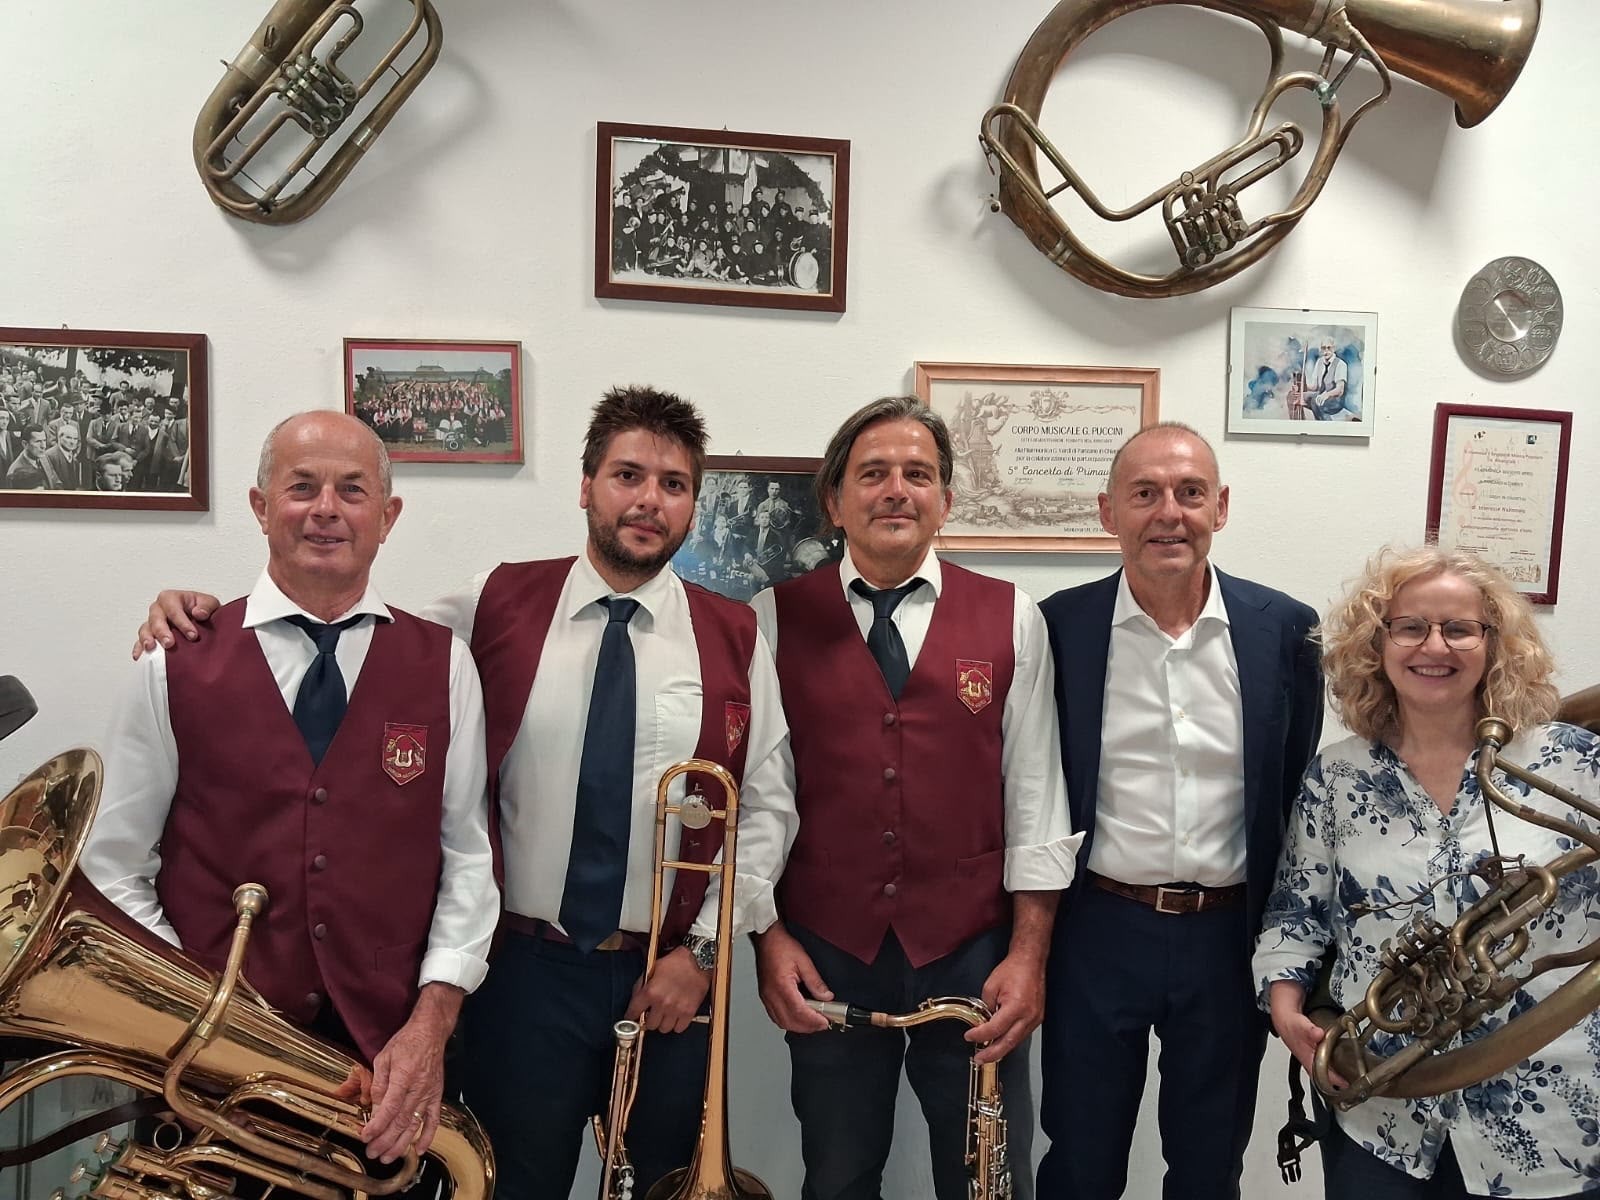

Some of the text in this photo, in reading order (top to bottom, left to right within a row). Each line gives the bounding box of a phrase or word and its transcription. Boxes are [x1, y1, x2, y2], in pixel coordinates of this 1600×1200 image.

[1011, 425, 1040, 435] CORPO
[1041, 426, 1080, 436] MUSICALE
[1091, 426, 1123, 436] PUCCINI
[1022, 465, 1062, 476] Concerto
[1063, 466, 1073, 476] di
